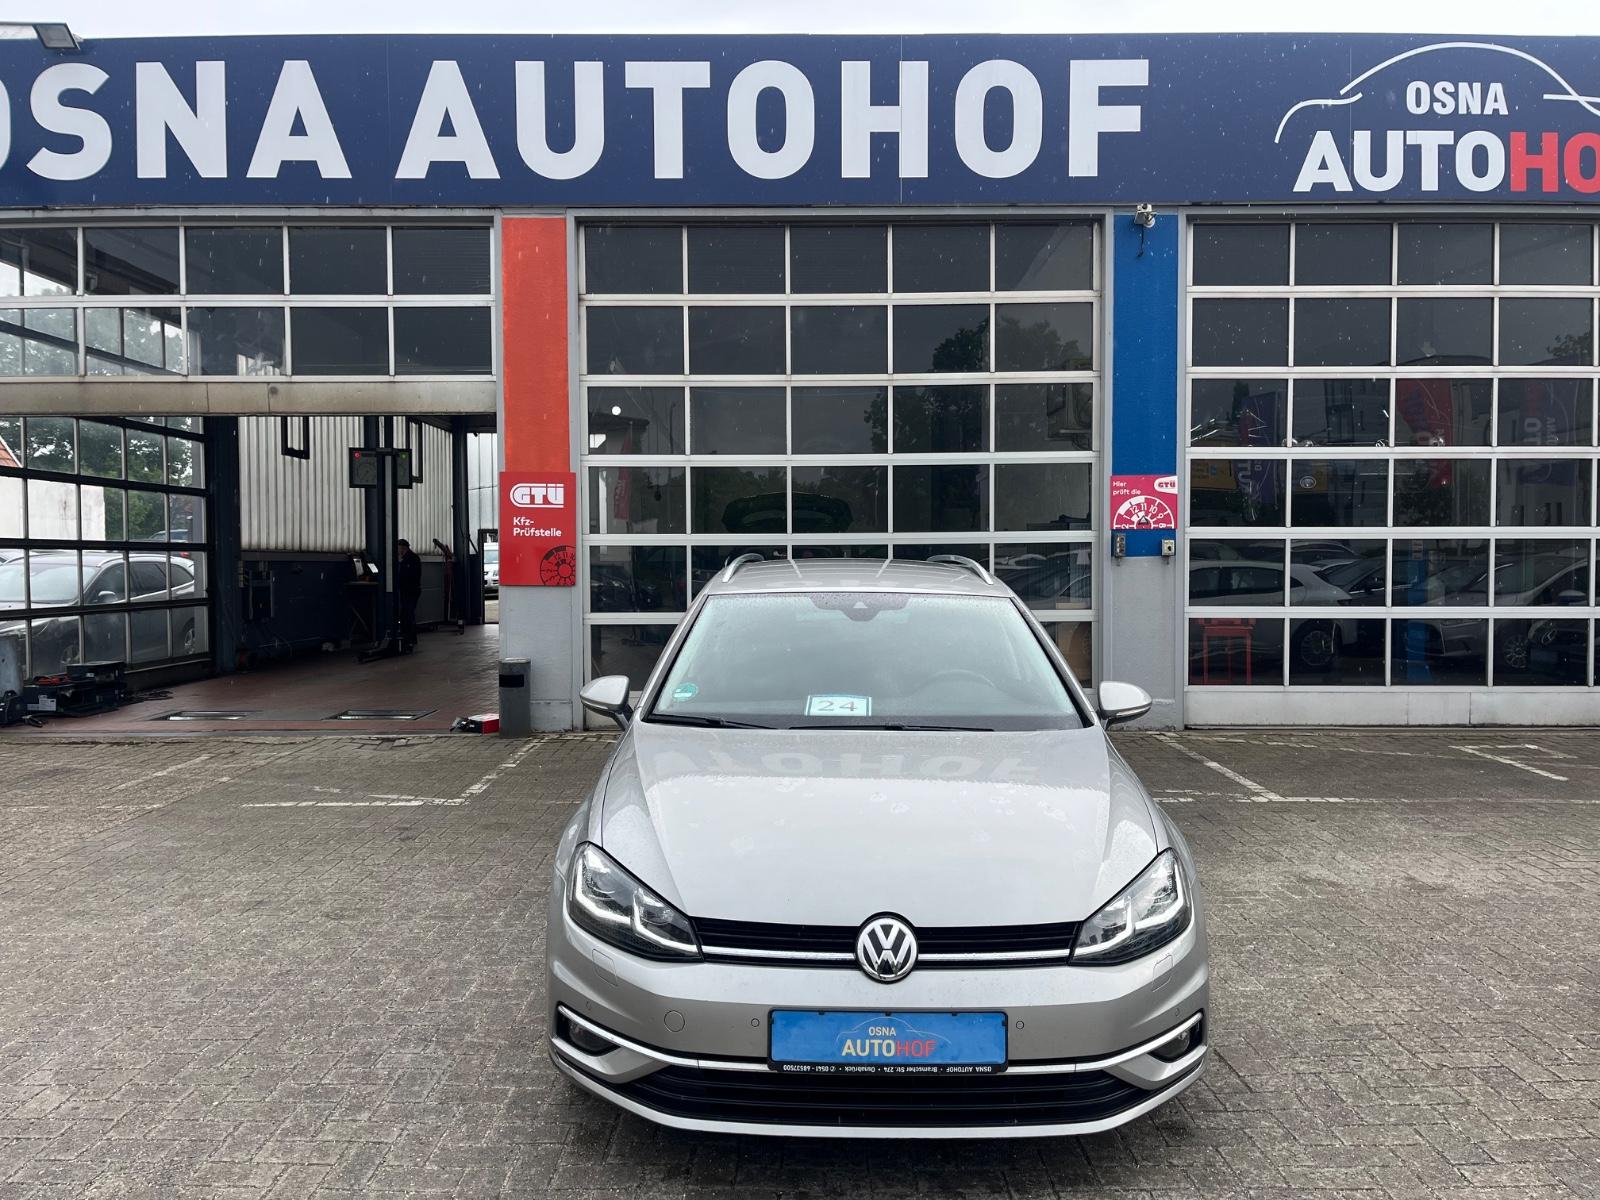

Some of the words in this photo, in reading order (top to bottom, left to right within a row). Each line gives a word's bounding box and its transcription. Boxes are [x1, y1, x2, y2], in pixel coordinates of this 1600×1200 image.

[1406, 81, 1508, 115] OSNA
[0, 60, 352, 180] SNA
[395, 59, 1150, 180] AUTOHOF
[510, 484, 564, 507] GTÜ
[1129, 505, 1140, 515] 12
[1140, 503, 1147, 511] 11
[1149, 505, 1158, 514] 10
[513, 516, 535, 526] Kfz-
[513, 527, 562, 537] Prüfstelle
[817, 700, 858, 712] 24
[868, 1026, 897, 1037] OSNA
[841, 1039, 938, 1057] AUTOHOF
[844, 1065, 876, 1073] Osnabrück
